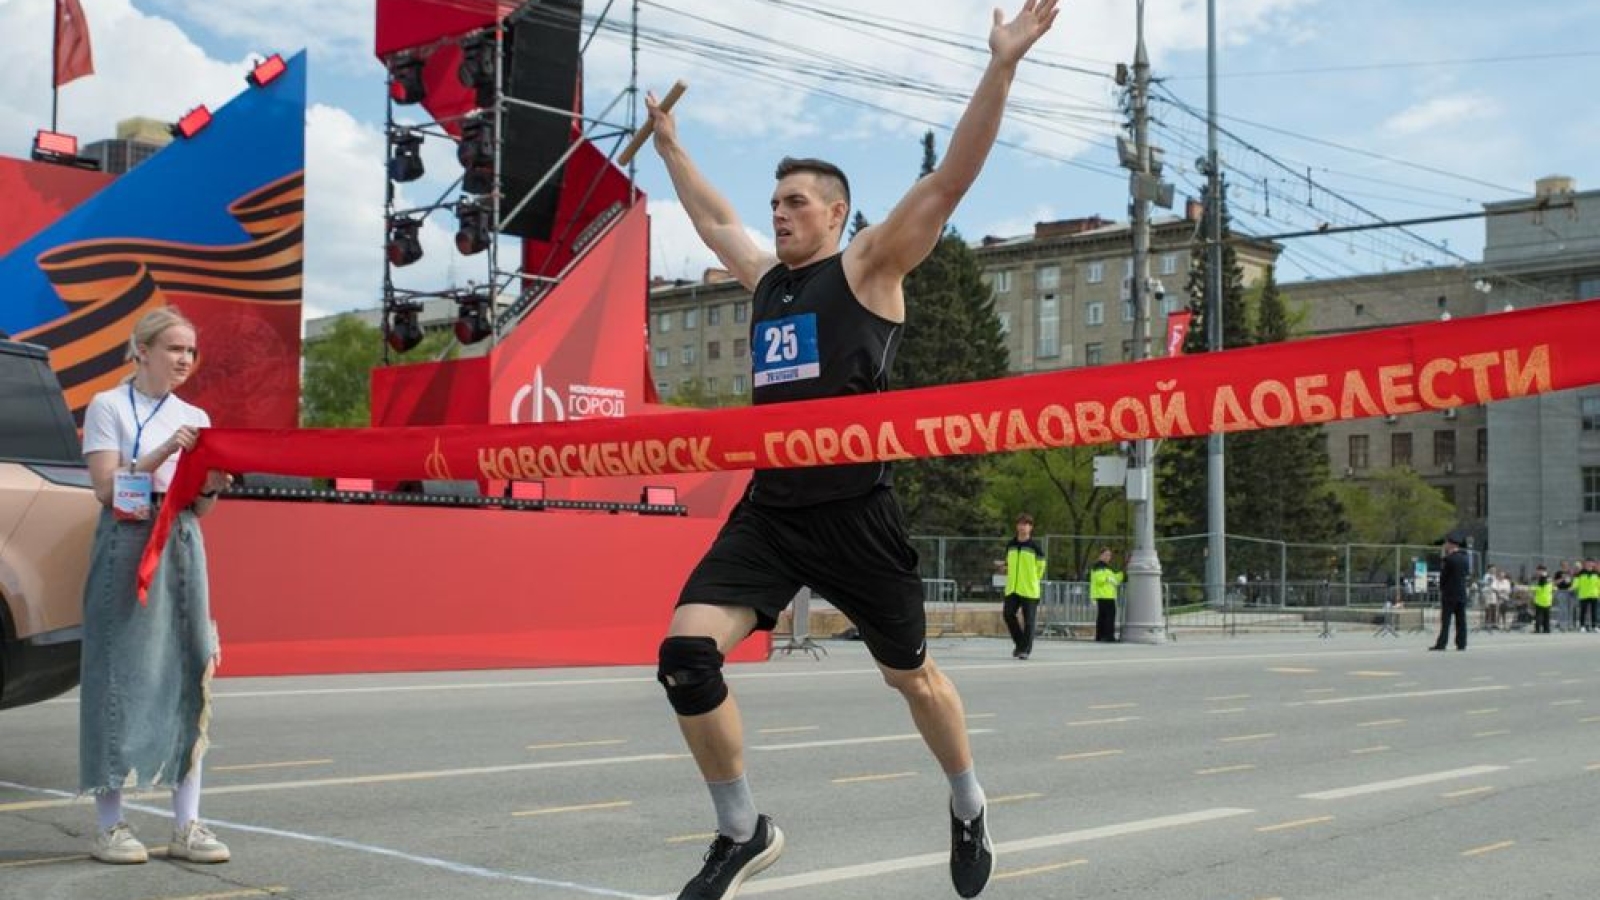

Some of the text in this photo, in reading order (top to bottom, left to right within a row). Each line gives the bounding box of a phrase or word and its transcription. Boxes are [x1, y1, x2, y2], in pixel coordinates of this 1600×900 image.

[765, 323, 799, 363] 25
[478, 436, 719, 478] НОВОСИБИРСК
[764, 421, 913, 468] ГОРОД
[916, 379, 1195, 456] ТРУДОВОЙ
[1209, 344, 1553, 429] ДОБЛЕСТИ
[569, 394, 625, 418] ГОРОД
